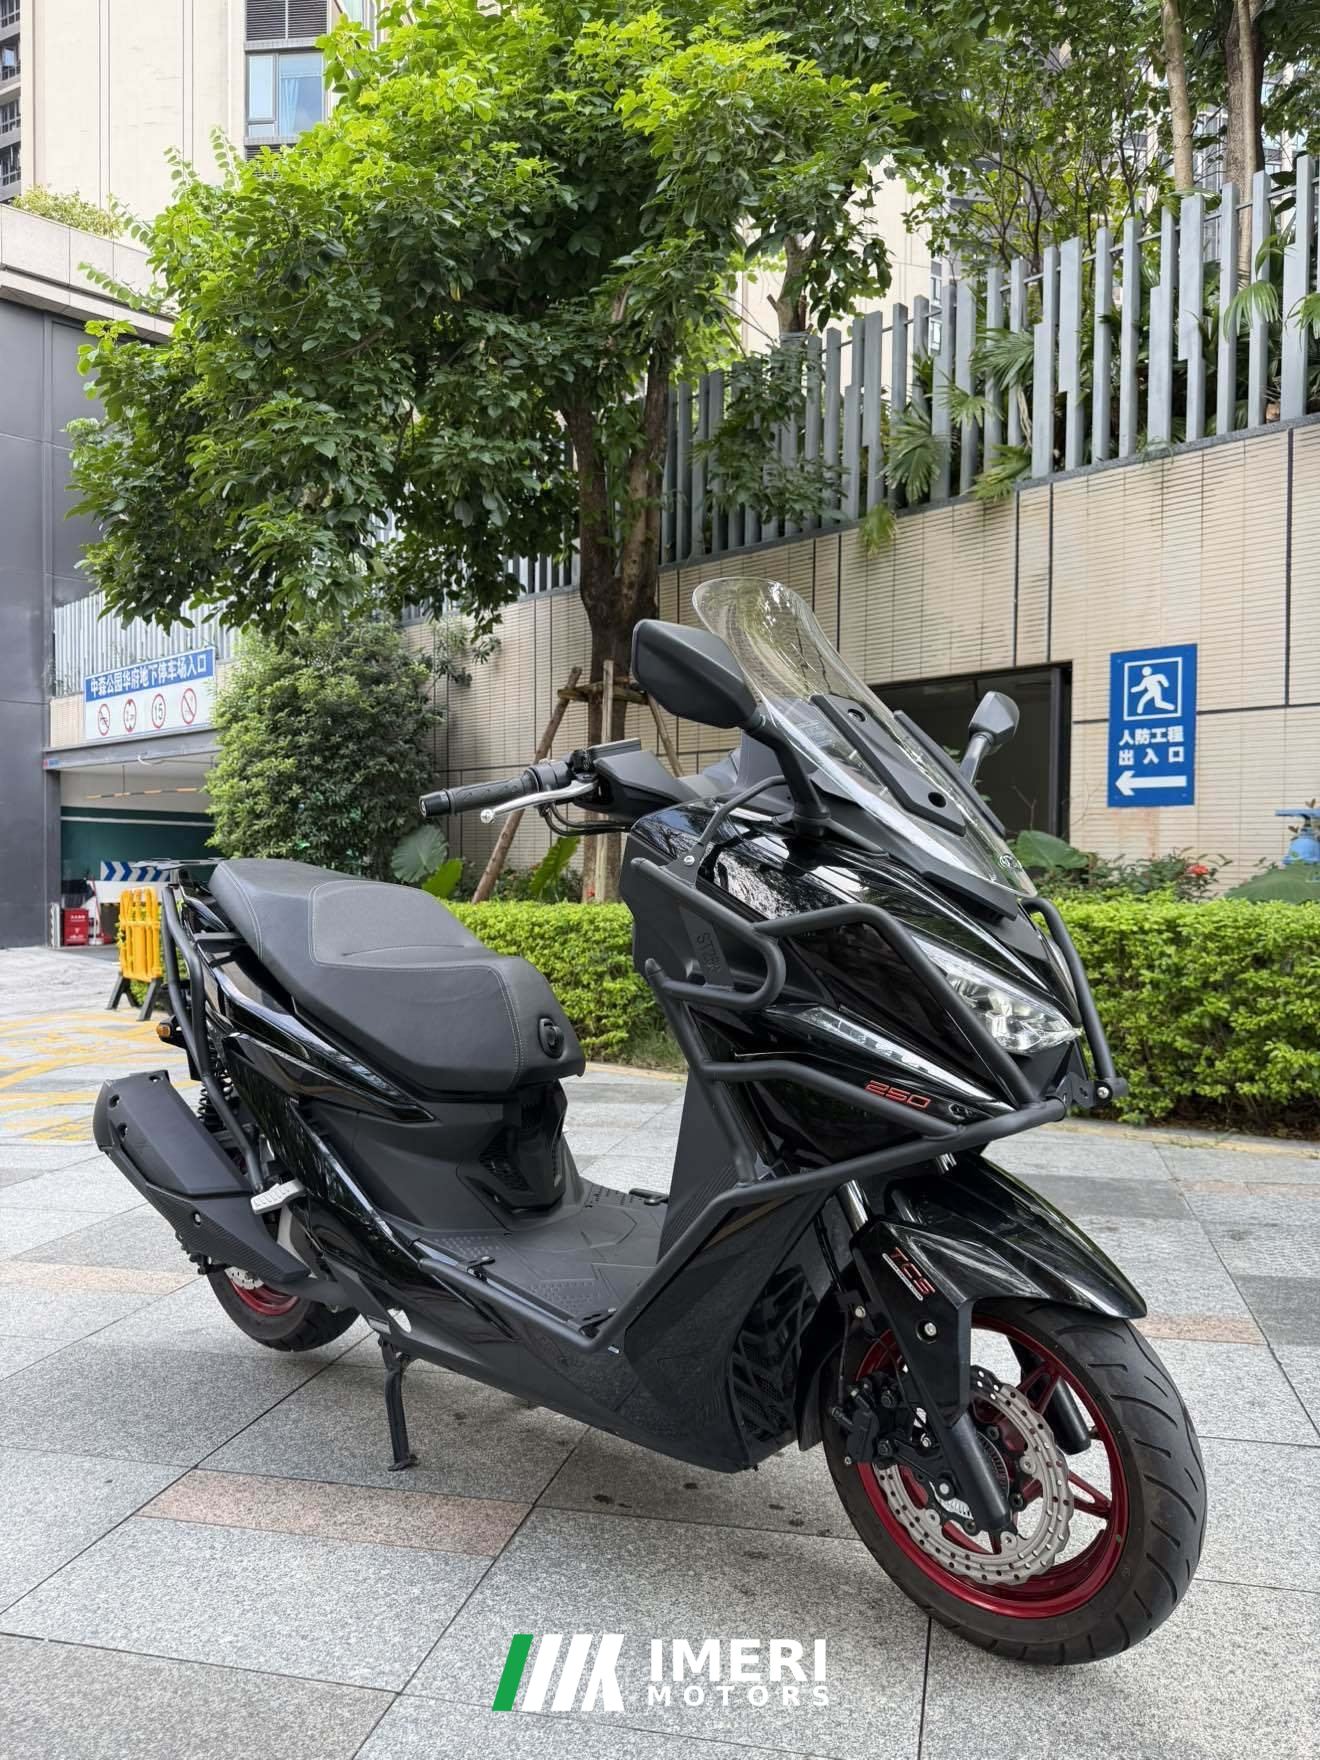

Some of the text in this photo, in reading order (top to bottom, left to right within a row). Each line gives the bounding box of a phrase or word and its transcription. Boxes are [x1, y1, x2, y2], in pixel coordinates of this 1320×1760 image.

[1119, 725, 1185, 746] 人防工程
[1118, 746, 1185, 766] 出入口
[864, 1080, 931, 1109] 250
[889, 1246, 936, 1296] TCS
